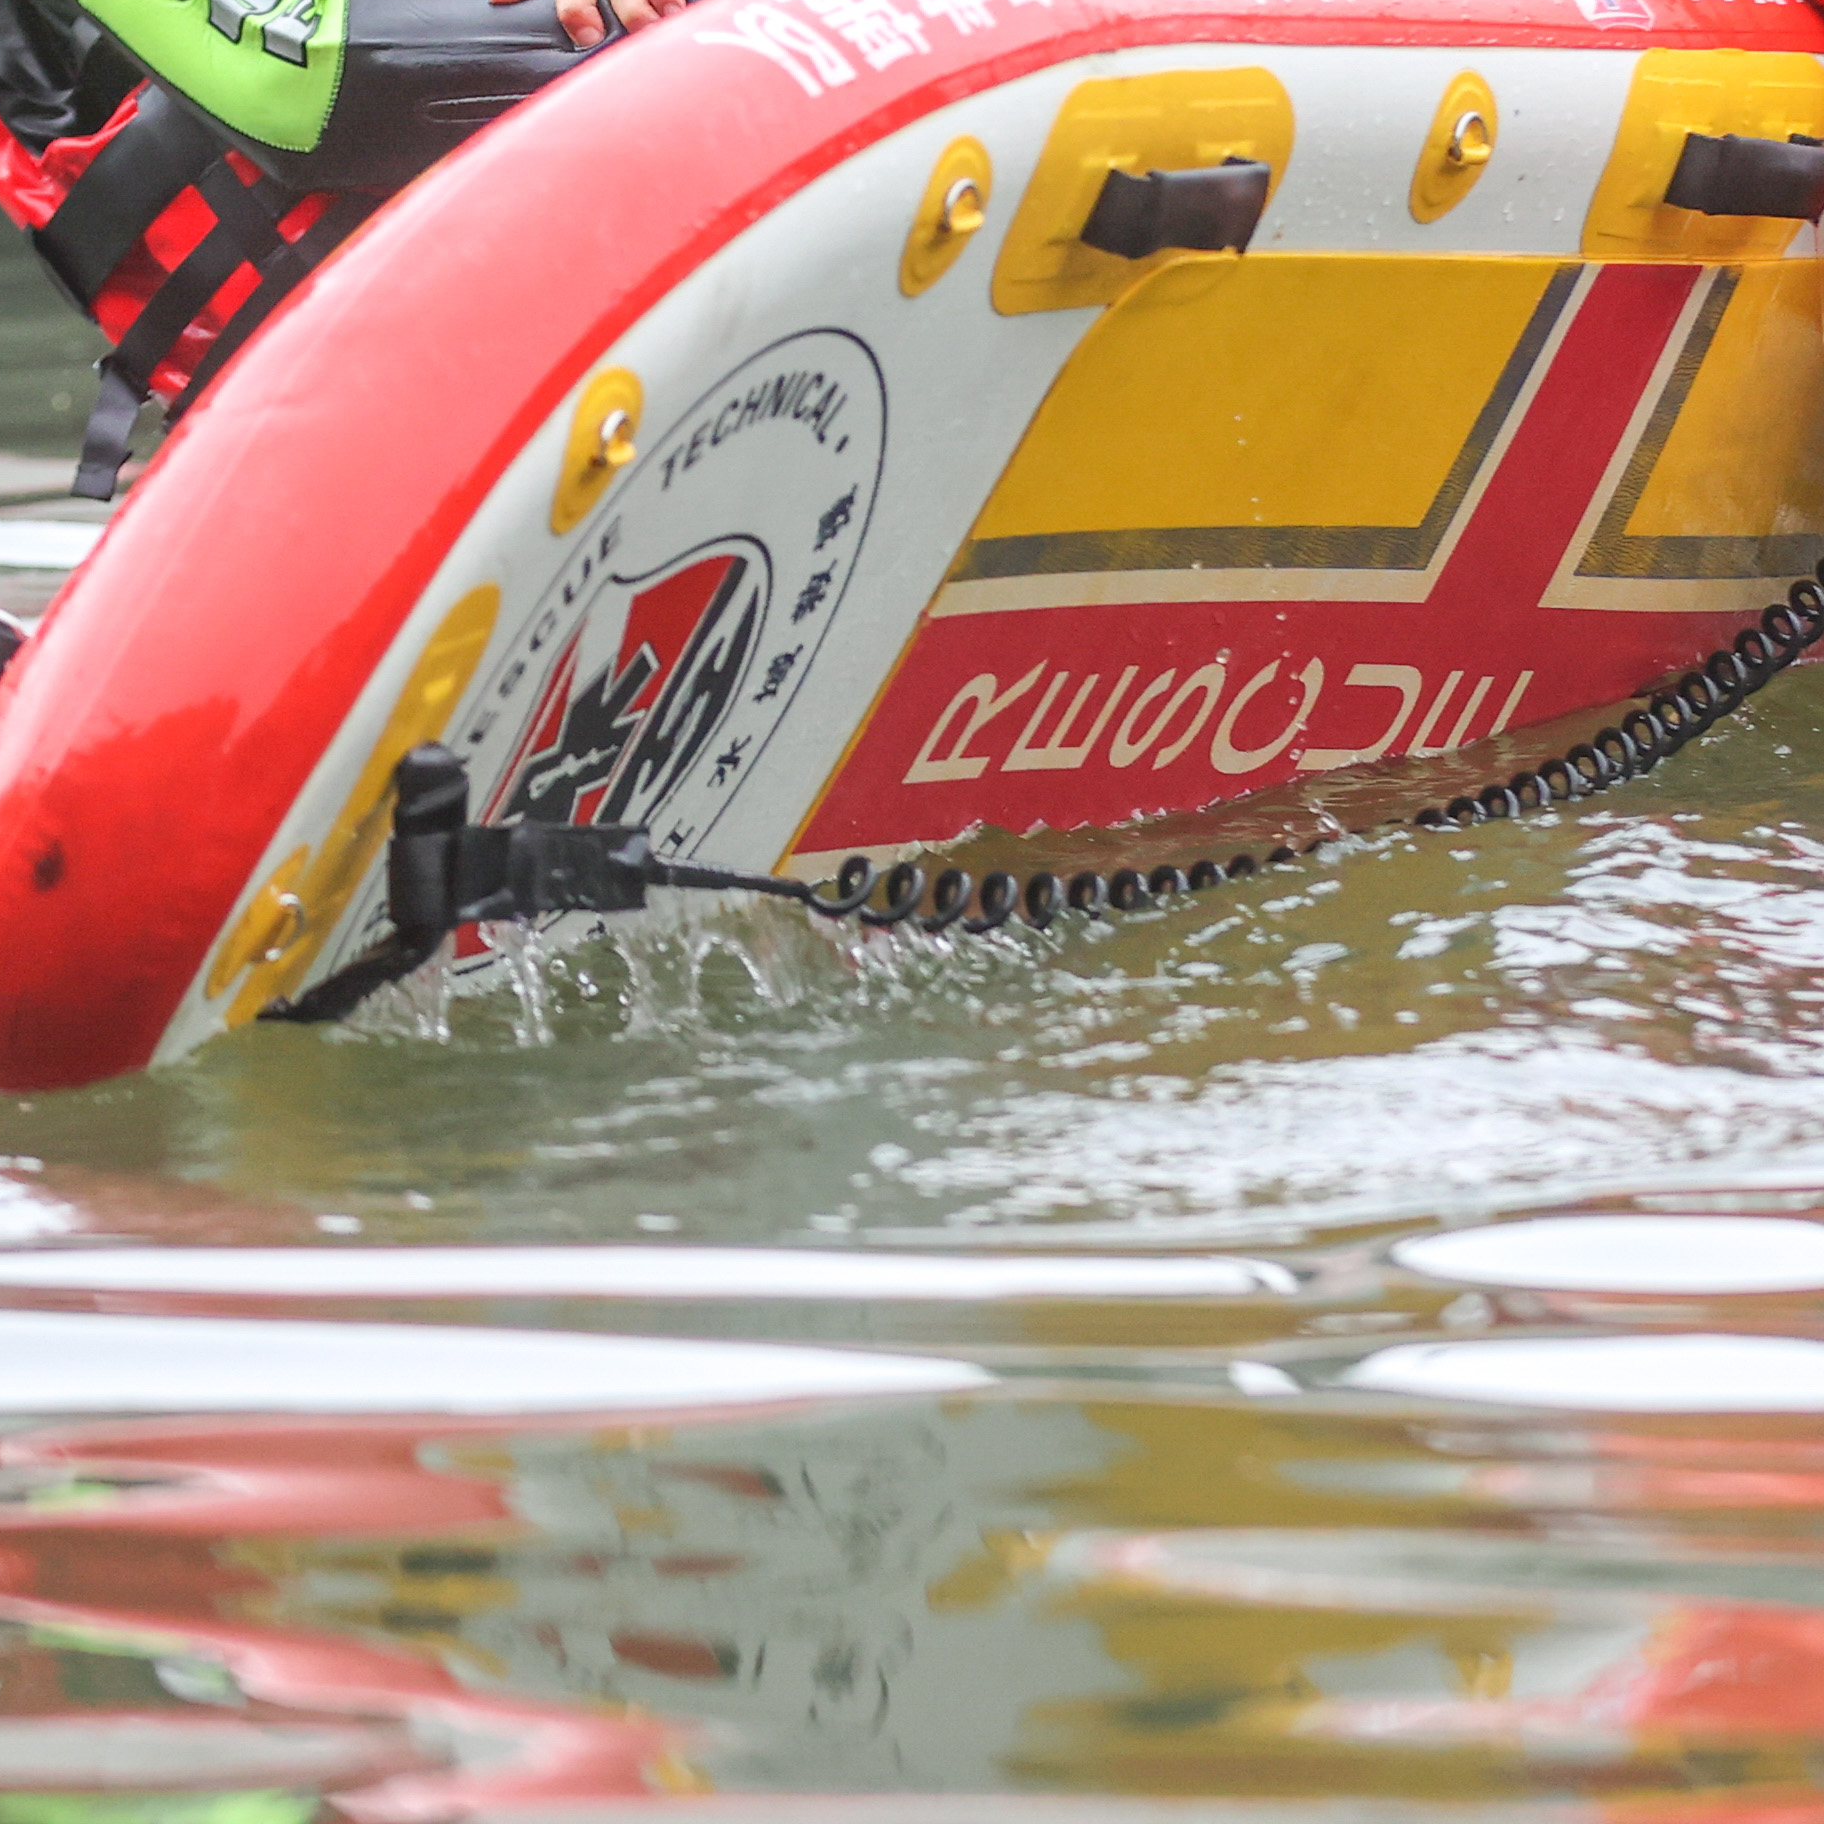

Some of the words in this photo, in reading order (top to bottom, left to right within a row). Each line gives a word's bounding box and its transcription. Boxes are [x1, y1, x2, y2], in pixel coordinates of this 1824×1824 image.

[464, 518, 625, 744] ESCUE
[657, 381, 845, 492] TECHNICAL
[902, 656, 1534, 786] RESCUE
